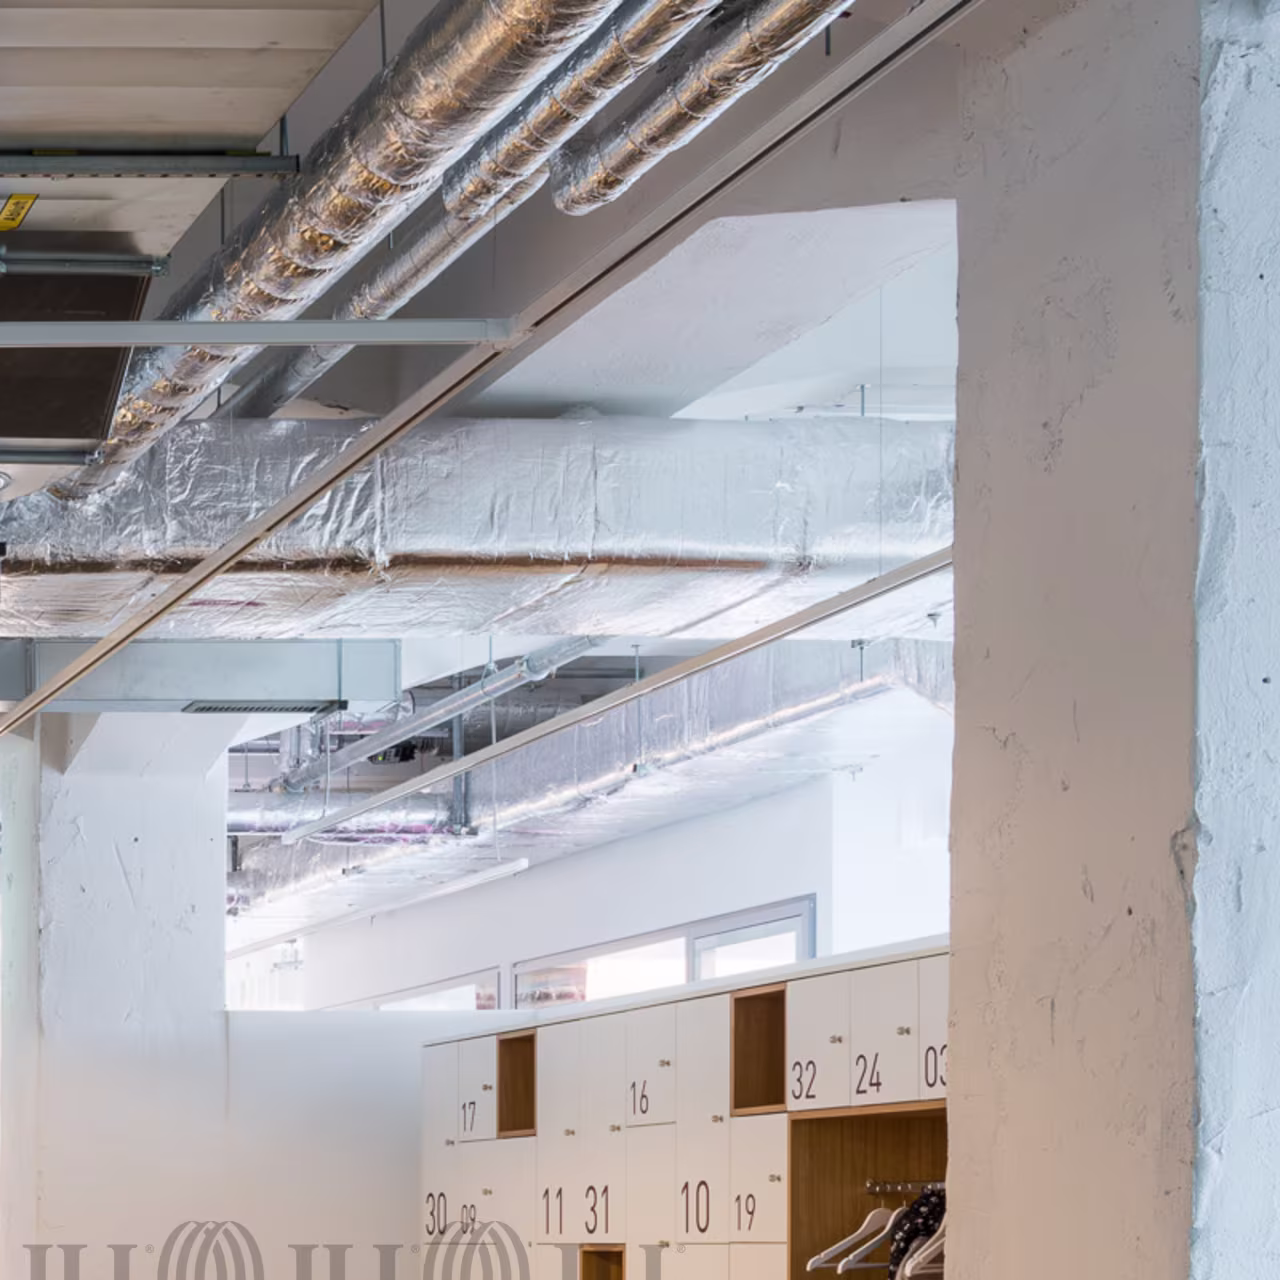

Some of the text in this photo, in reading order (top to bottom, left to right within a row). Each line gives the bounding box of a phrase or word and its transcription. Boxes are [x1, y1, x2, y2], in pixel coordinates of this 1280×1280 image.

[791, 1059, 817, 1101] 32
[855, 1052, 883, 1096] 24
[461, 1100, 477, 1132] 17
[630, 1079, 649, 1115] 16
[425, 1192, 447, 1236] 30
[460, 1204, 476, 1235] 09
[542, 1186, 563, 1235] 11
[584, 1184, 609, 1235] 31
[680, 1179, 710, 1234] 10
[734, 1193, 756, 1232] 19
